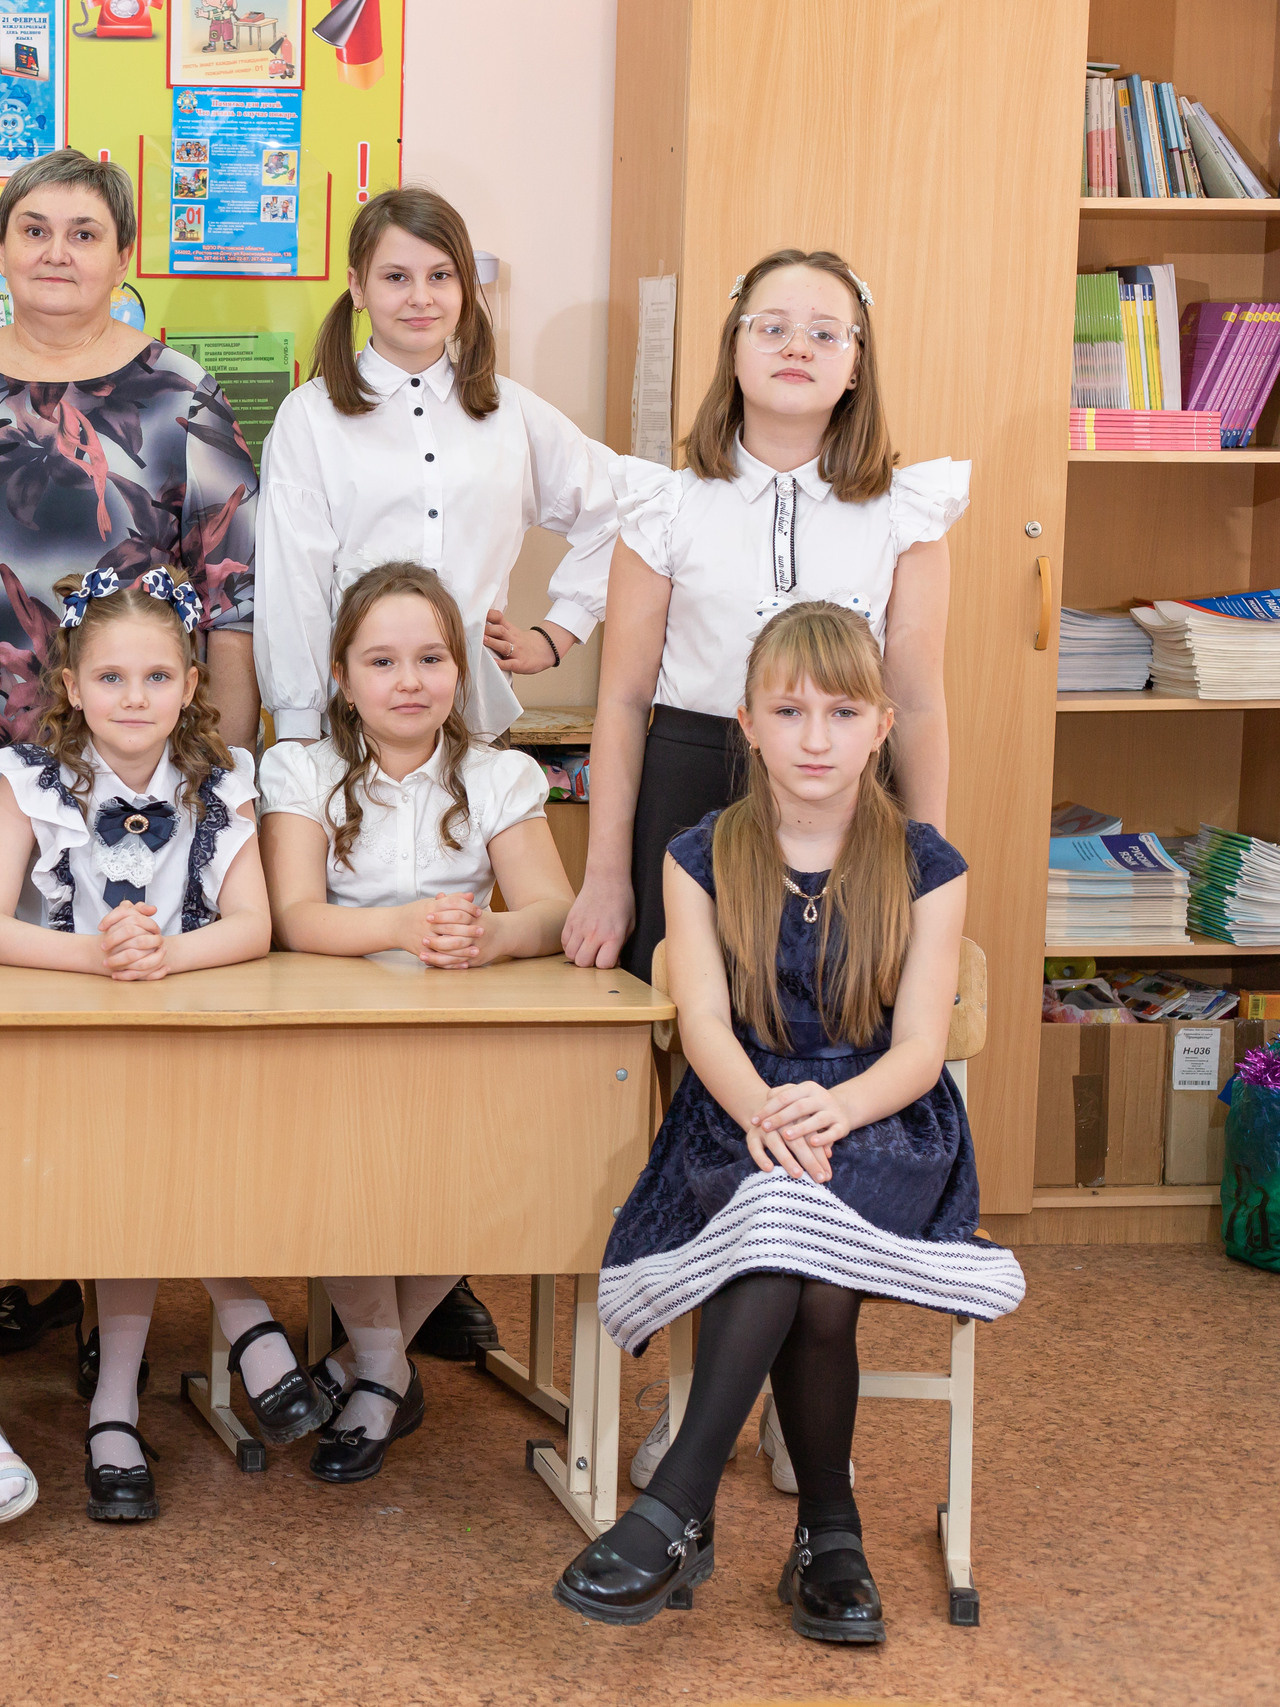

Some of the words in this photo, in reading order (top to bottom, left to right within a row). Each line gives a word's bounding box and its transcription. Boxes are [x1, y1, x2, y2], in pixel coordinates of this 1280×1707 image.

[254, 64, 264, 72] 01
[211, 99, 245, 107] Памятка
[196, 108, 210, 116] Что
[243, 110, 268, 119] случае
[269, 111, 298, 120] пожара.
[186, 207, 201, 225] 01
[1182, 1047, 1211, 1055] H-036
